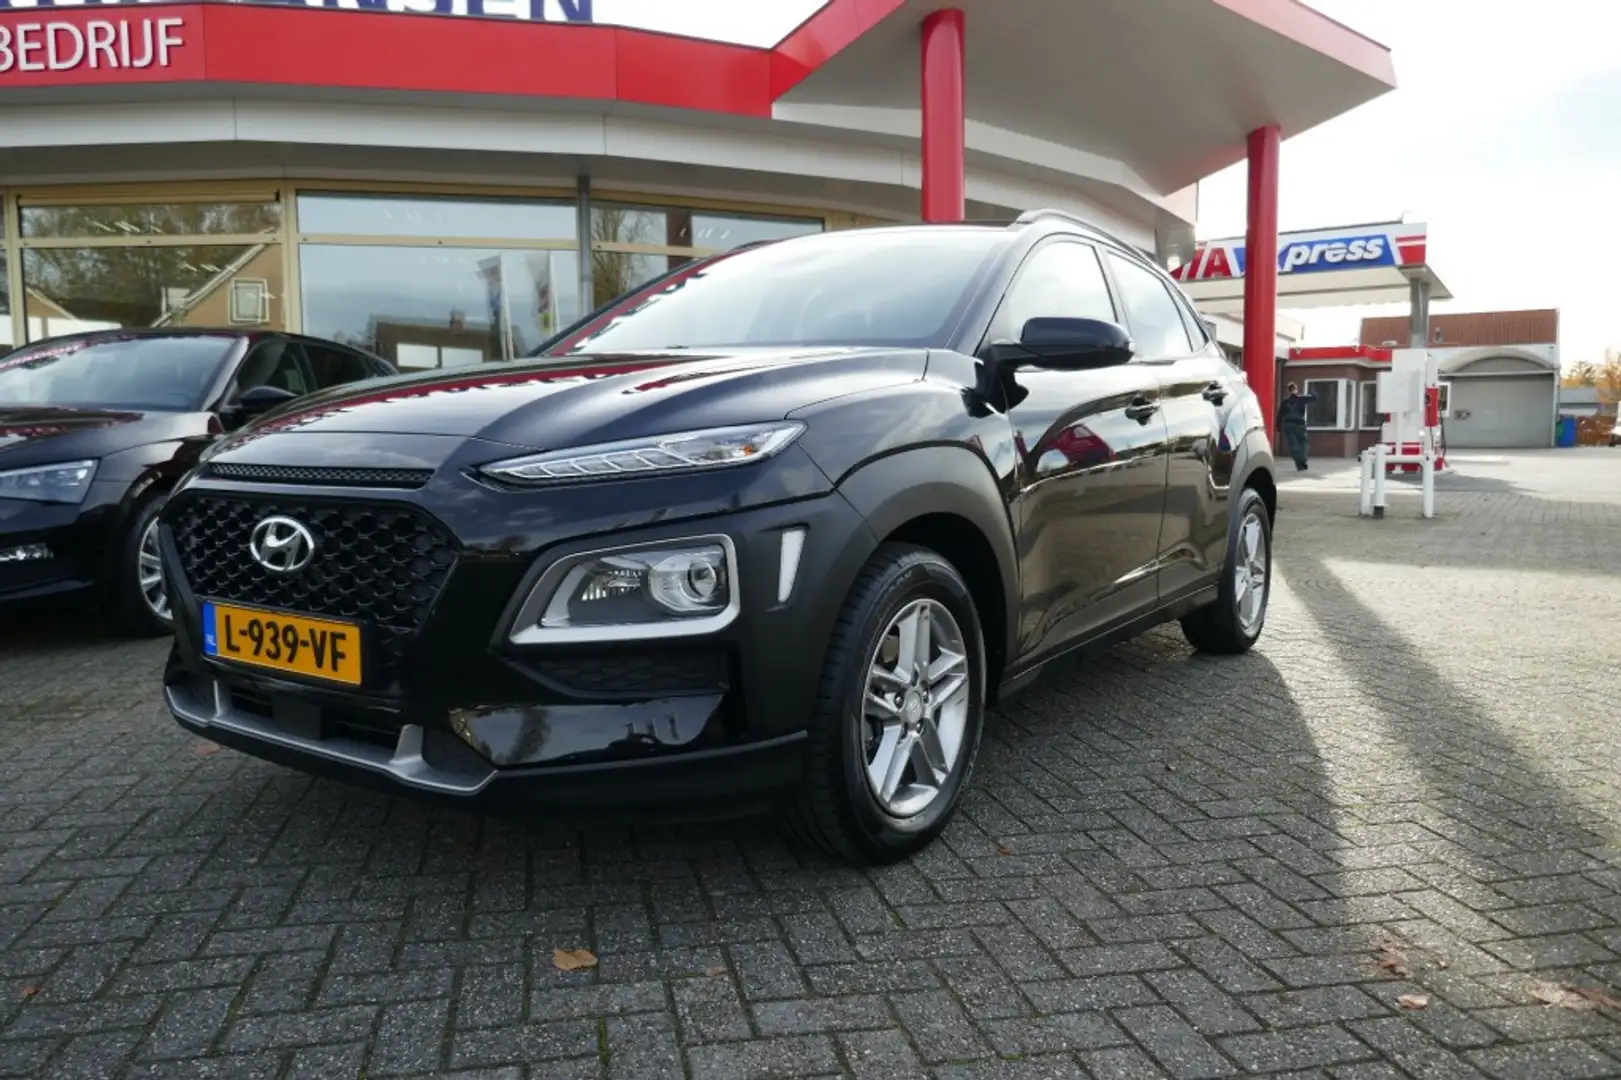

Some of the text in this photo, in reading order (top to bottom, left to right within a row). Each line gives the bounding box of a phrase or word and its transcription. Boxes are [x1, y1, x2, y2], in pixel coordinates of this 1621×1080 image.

[1169, 239, 1384, 280] IA press
[224, 614, 347, 673] L-939-VF
